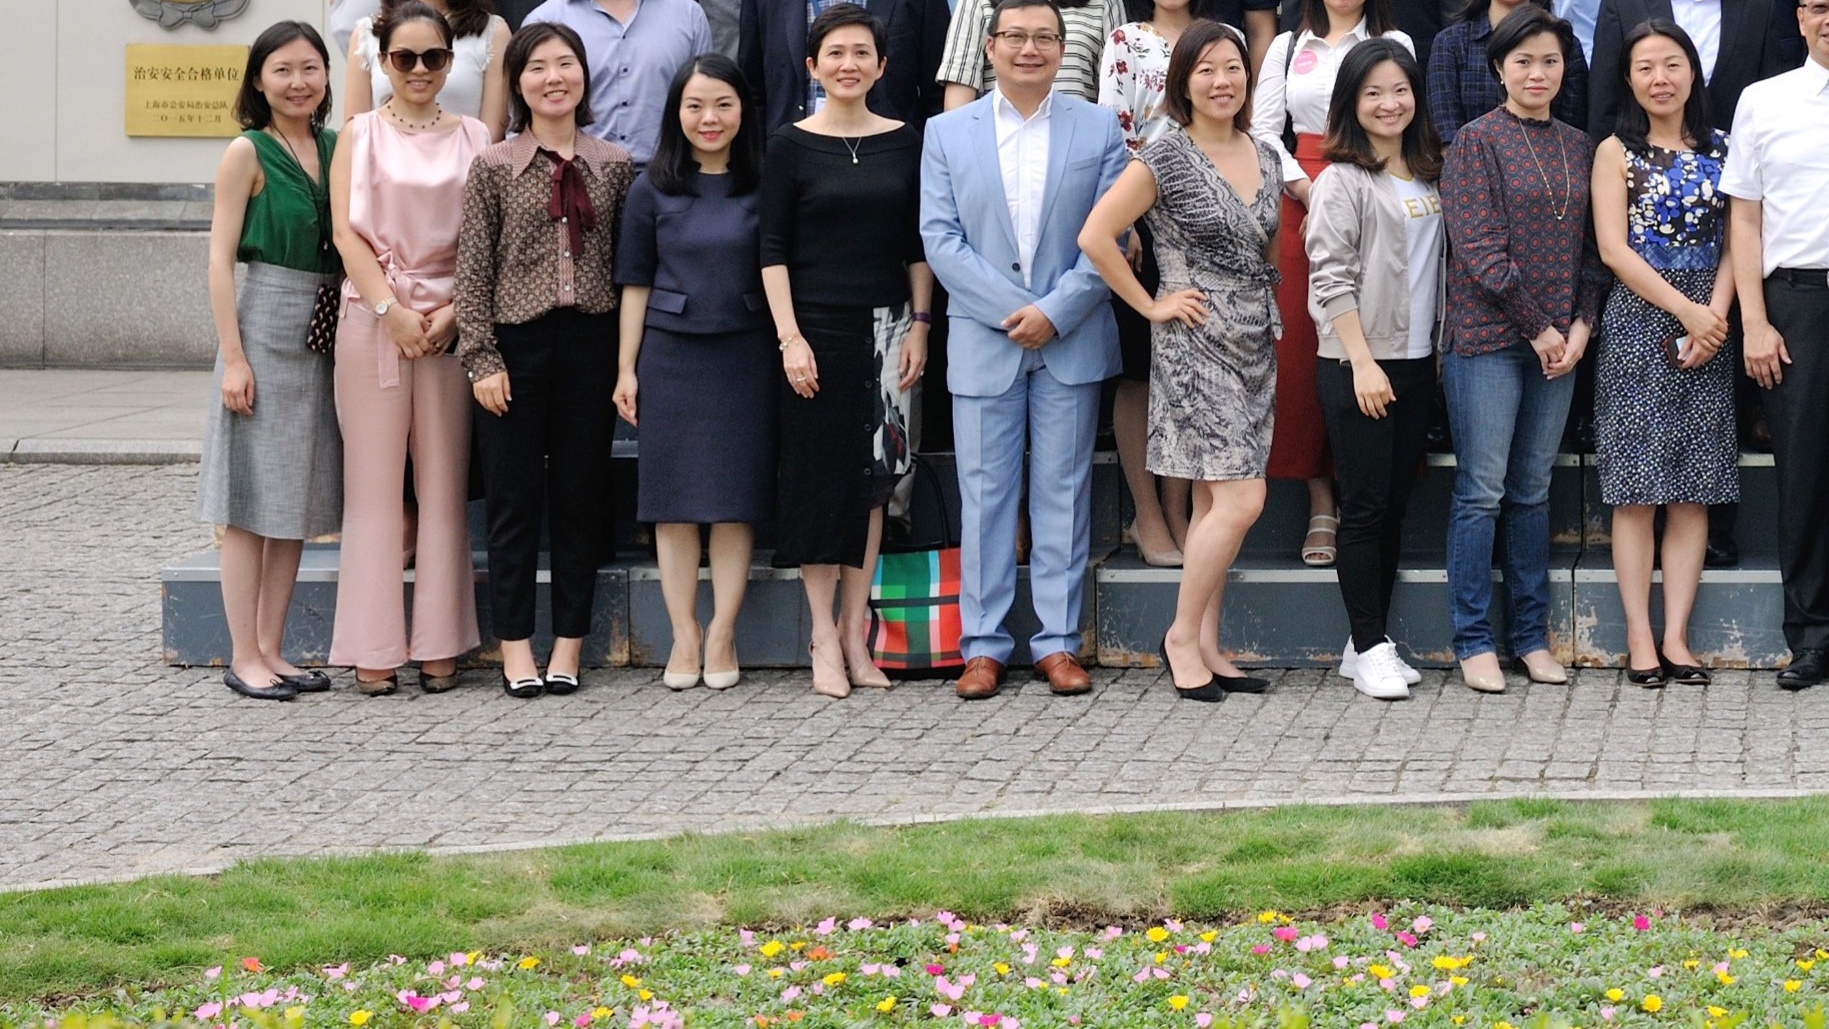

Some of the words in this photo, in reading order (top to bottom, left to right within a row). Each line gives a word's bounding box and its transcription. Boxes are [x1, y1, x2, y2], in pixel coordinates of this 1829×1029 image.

[134, 66, 240, 81] 治安安全合格单位
